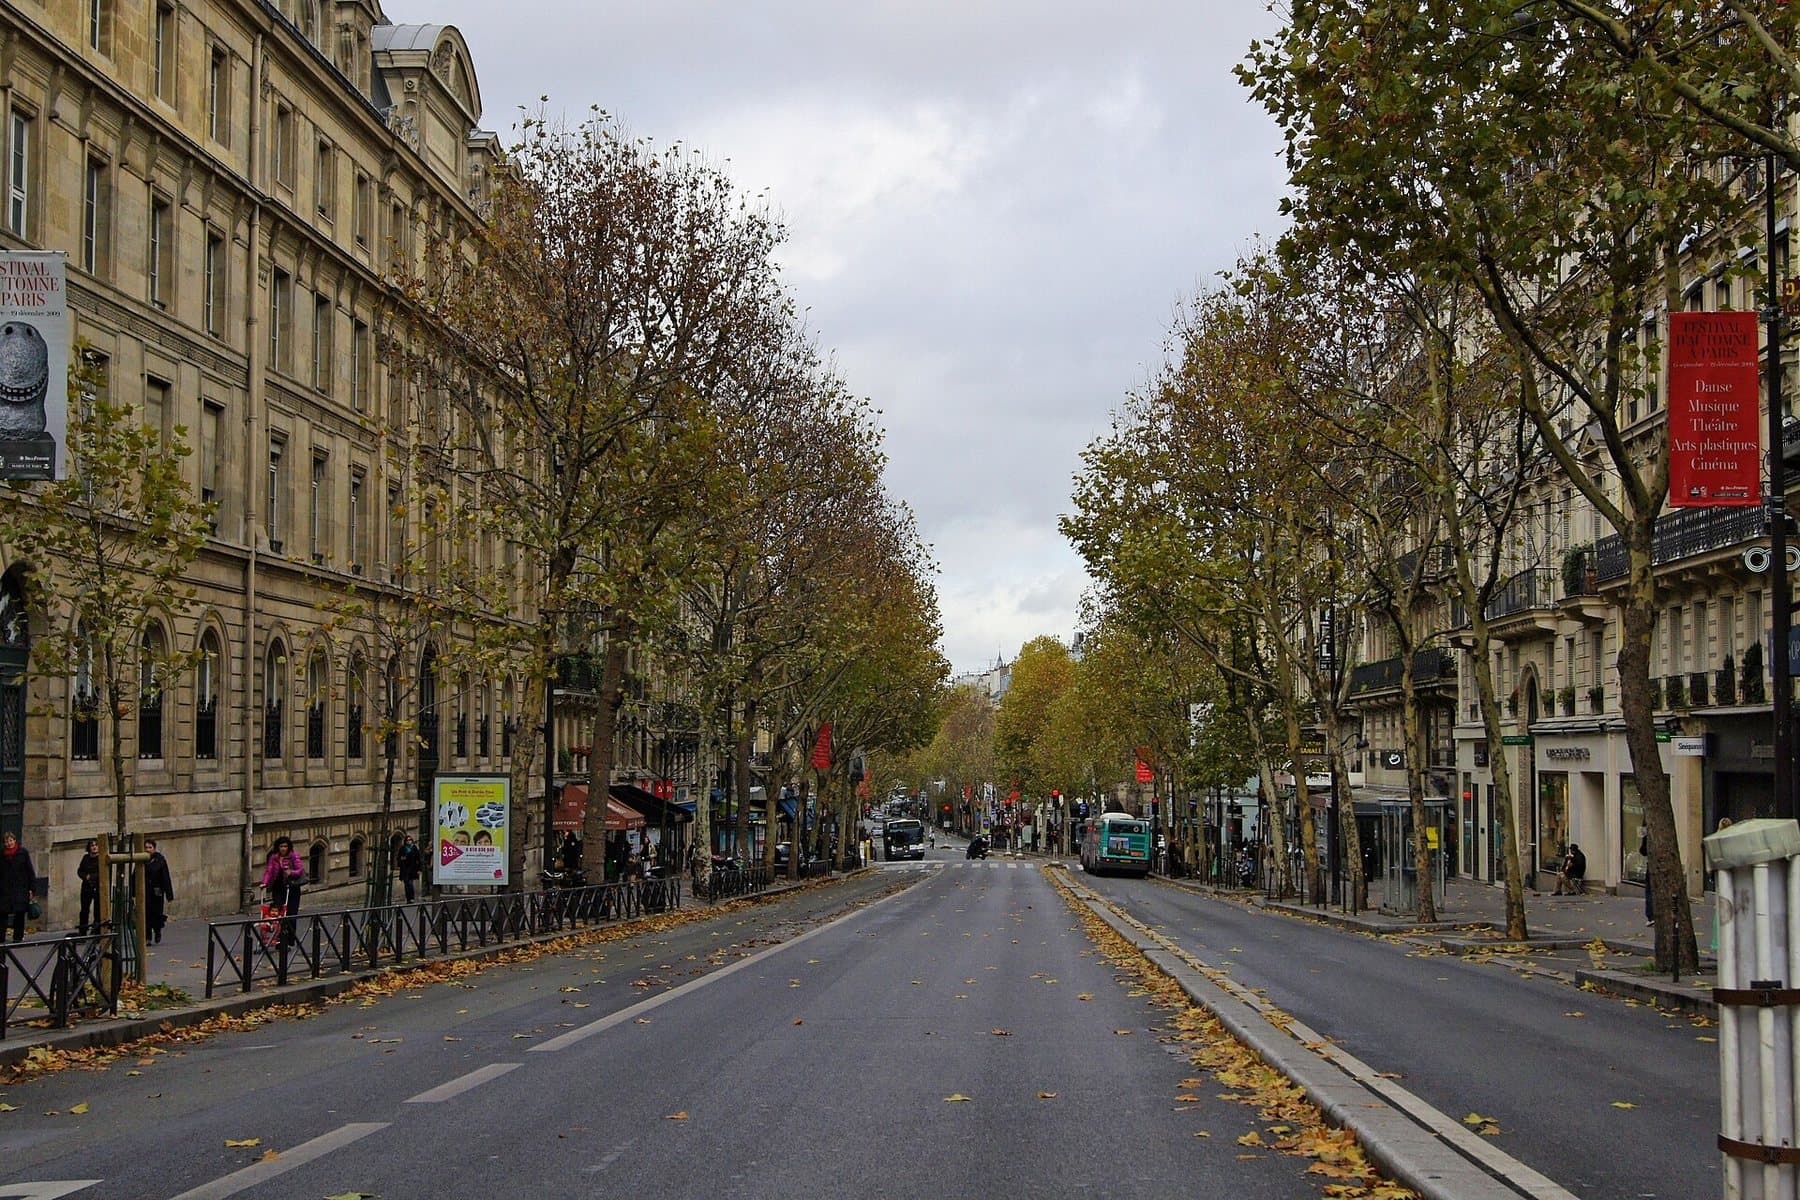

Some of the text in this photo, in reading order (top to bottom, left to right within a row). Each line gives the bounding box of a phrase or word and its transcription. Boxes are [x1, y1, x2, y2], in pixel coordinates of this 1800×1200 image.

[1, 291, 46, 307] PARIS
[1683, 321, 1741, 334] FESTIVAL
[1700, 347, 1738, 359] PARIS
[1695, 379, 1733, 394] Danse
[1688, 399, 1740, 416] Musique
[1690, 417, 1738, 433] Théâtre
[1672, 438, 1757, 456] Arts plastiques
[1691, 457, 1738, 471] Cinéma
